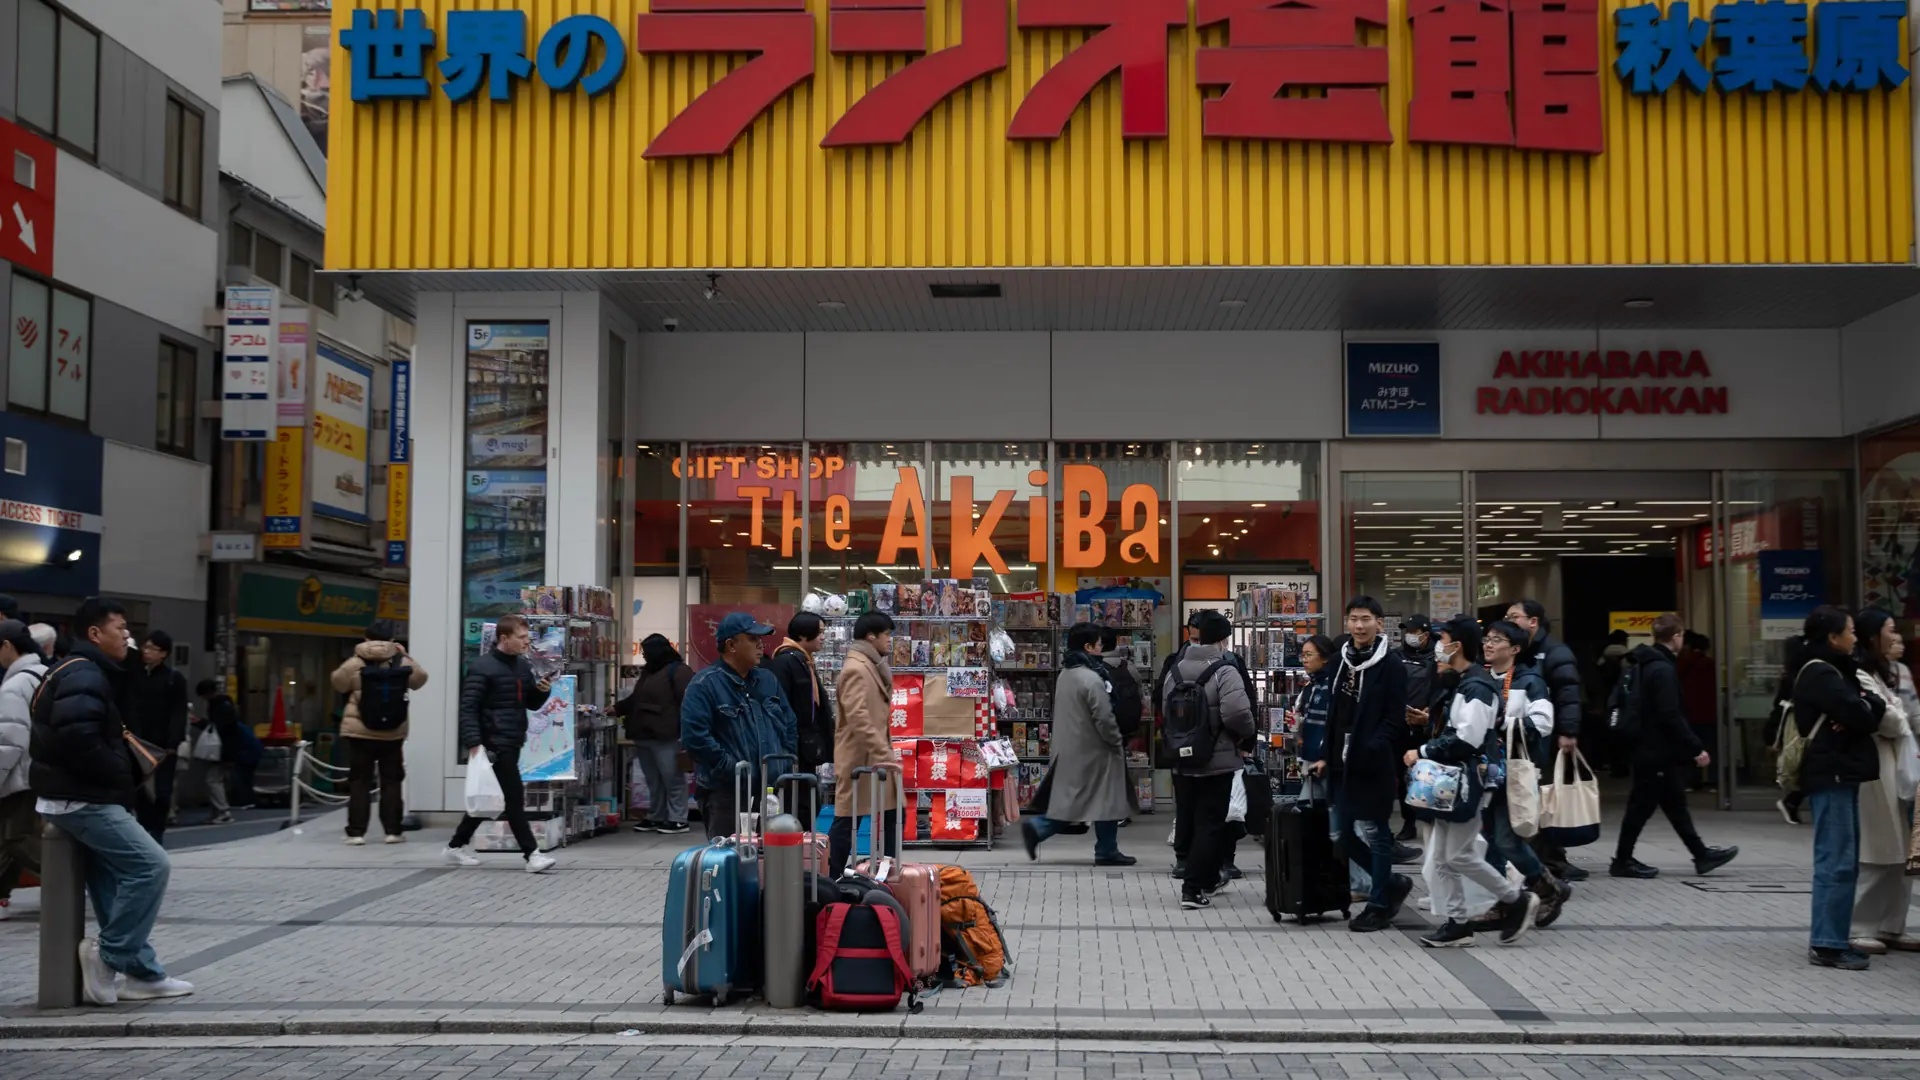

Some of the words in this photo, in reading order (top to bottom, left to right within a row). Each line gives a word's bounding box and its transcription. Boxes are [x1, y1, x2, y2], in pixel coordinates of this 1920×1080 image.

[340, 9, 626, 102] 世界の
[1614, 1, 1910, 94] 秋葉原
[229, 334, 267, 347] アコム
[473, 328, 490, 340] 5F
[1368, 361, 1420, 374] MIZUHO
[1492, 349, 1711, 380] AKIHABARA
[1377, 386, 1410, 398] みずほ
[1476, 386, 1729, 415] RADIOKAIKAN
[1361, 398, 1427, 410] ATMコーナー
[501, 438, 529, 452] magi
[671, 456, 746, 479] GIFT
[755, 456, 845, 479] SHOP
[471, 475, 487, 487] 5F
[0, 500, 42, 522] ACCESS
[47, 508, 83, 528] TICKET
[737, 486, 850, 558] The
[497, 585, 521, 600] mag
[890, 688, 909, 728] 福袋
[930, 748, 948, 780] 福袋
